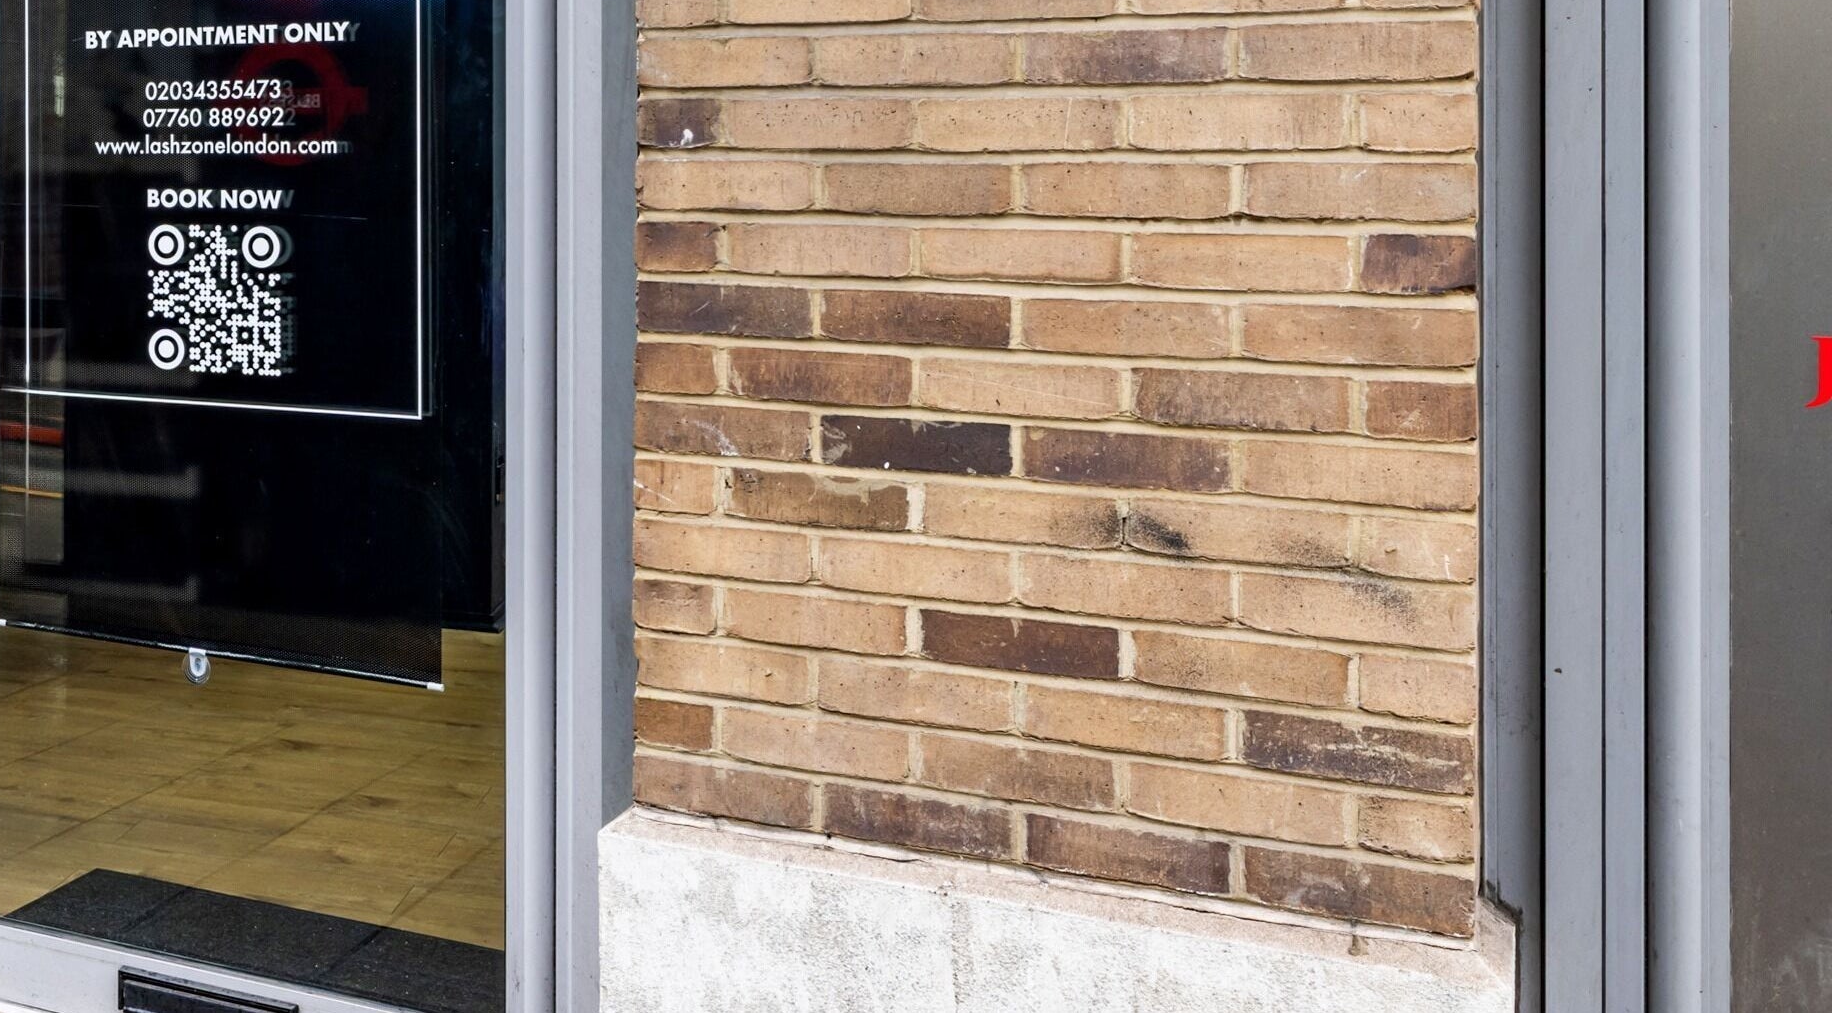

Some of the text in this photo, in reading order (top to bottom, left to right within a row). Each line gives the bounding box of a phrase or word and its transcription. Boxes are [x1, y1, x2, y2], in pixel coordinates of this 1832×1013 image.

[85, 21, 350, 49] BY APPOINTMENT ONLY
[145, 79, 282, 101] 02034355473
[143, 107, 284, 128] 07760 889692
[94, 133, 338, 155] www.lashzonelondon.com
[147, 189, 282, 210] BOOK NOW
